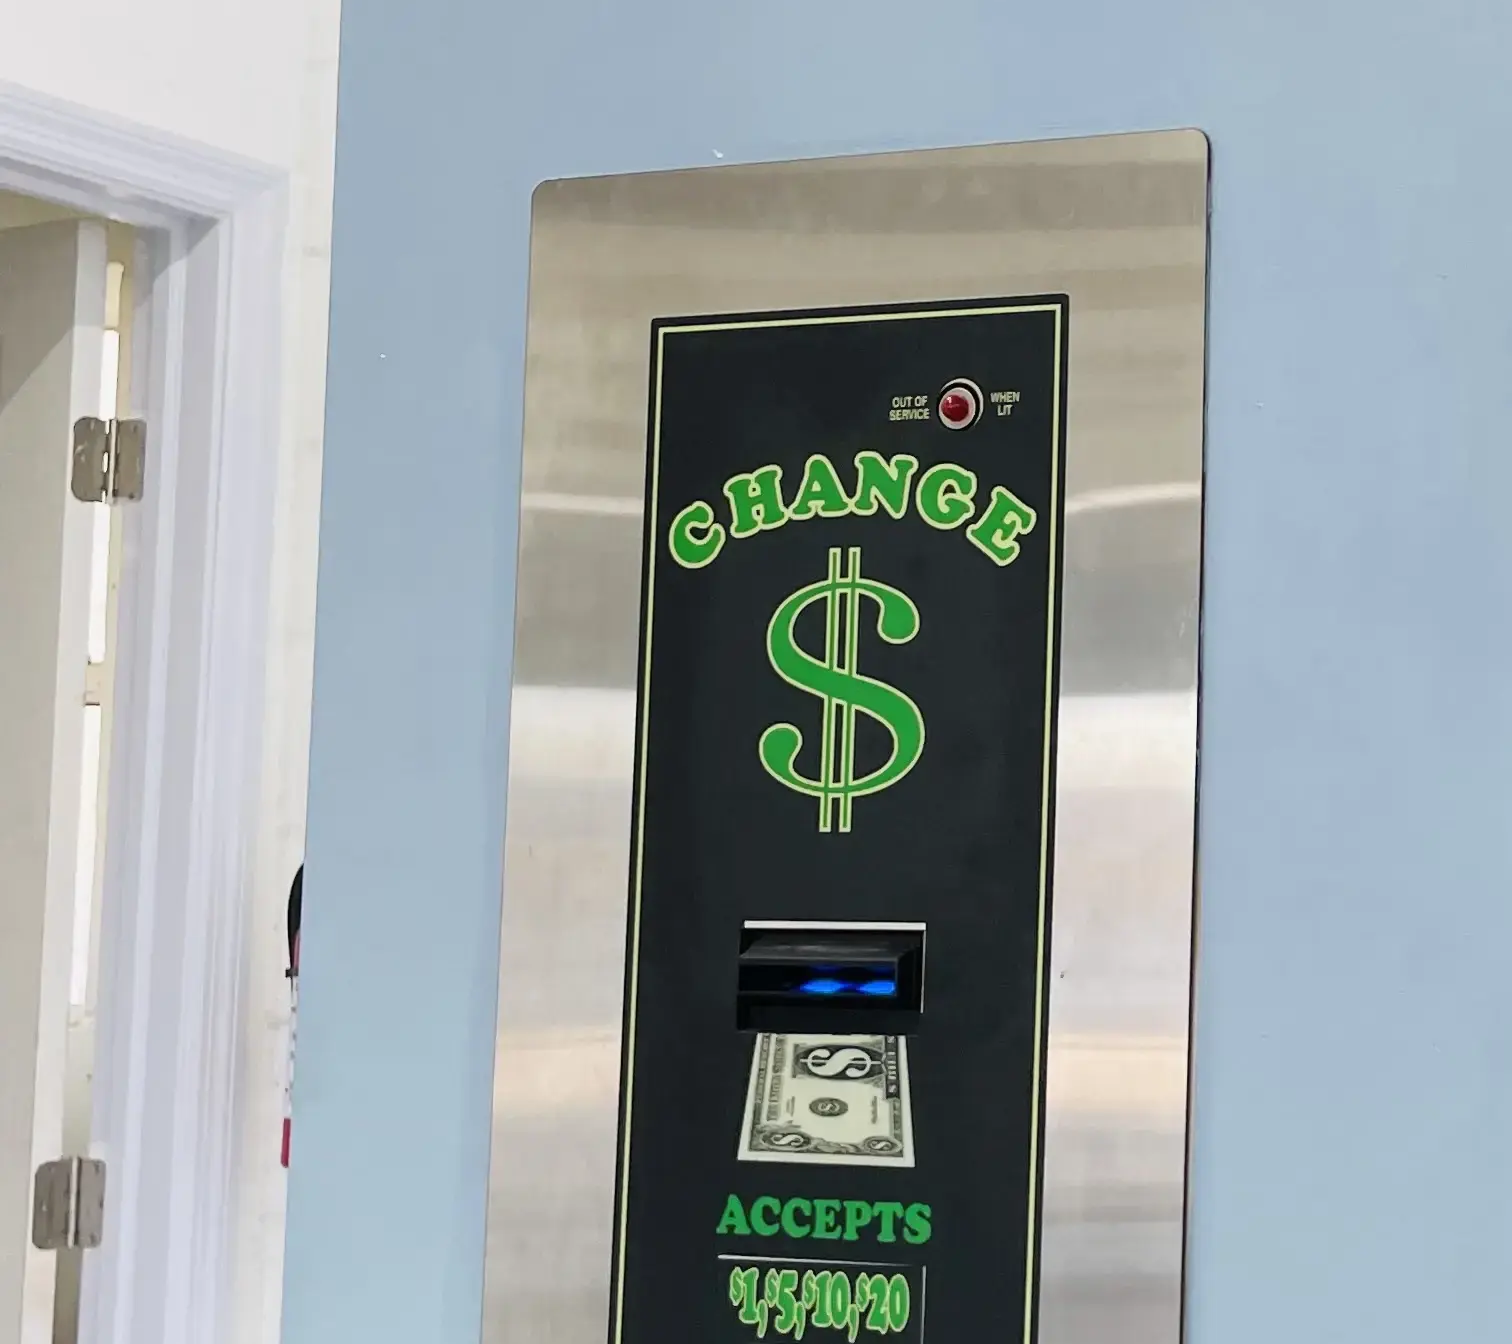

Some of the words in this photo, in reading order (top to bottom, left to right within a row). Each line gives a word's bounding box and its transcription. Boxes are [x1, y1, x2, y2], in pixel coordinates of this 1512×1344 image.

[892, 396, 913, 408] OUT
[915, 395, 928, 407] OF
[990, 391, 1020, 403] WHEN
[889, 408, 930, 421] SERVICE
[997, 404, 1013, 416] LIT
[668, 451, 1037, 569] CHANGE
[716, 1194, 932, 1245] ACCEPTS
